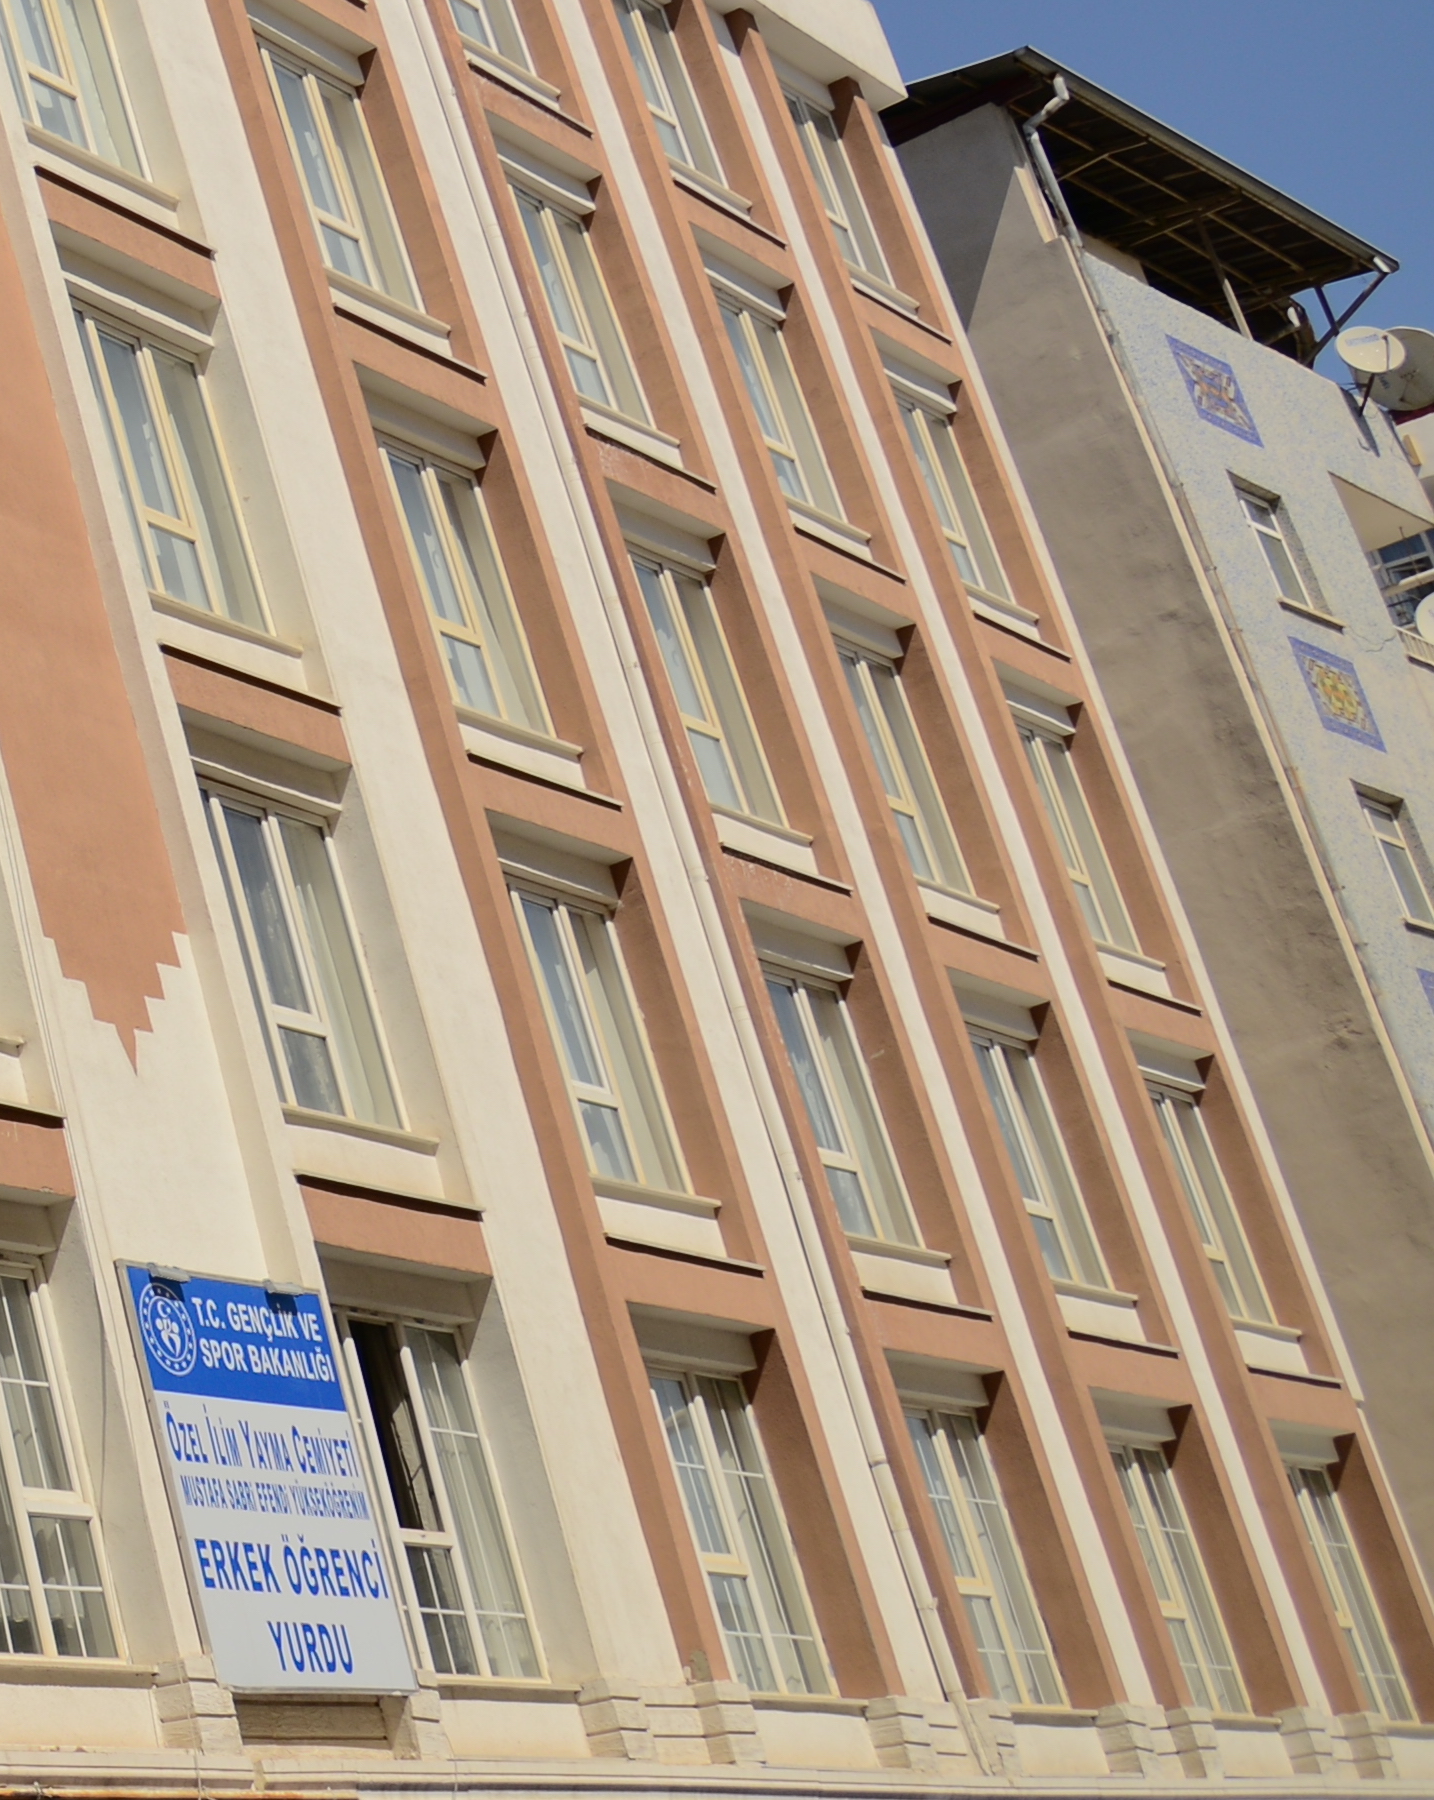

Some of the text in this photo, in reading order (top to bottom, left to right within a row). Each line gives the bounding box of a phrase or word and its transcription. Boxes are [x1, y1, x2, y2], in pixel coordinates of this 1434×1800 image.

[191, 1296, 323, 1342] T.C. GENÇLİK VE
[200, 1338, 336, 1383] SPOR BAKANLIĞI
[164, 1400, 360, 1478] ÖZEL İLİM YAYMA CEMİYETİ
[180, 1474, 228, 1509] MUSTAFA
[194, 1533, 389, 1599] ERKEK ÖĞRENCİ
[267, 1620, 354, 1675] YURDU
